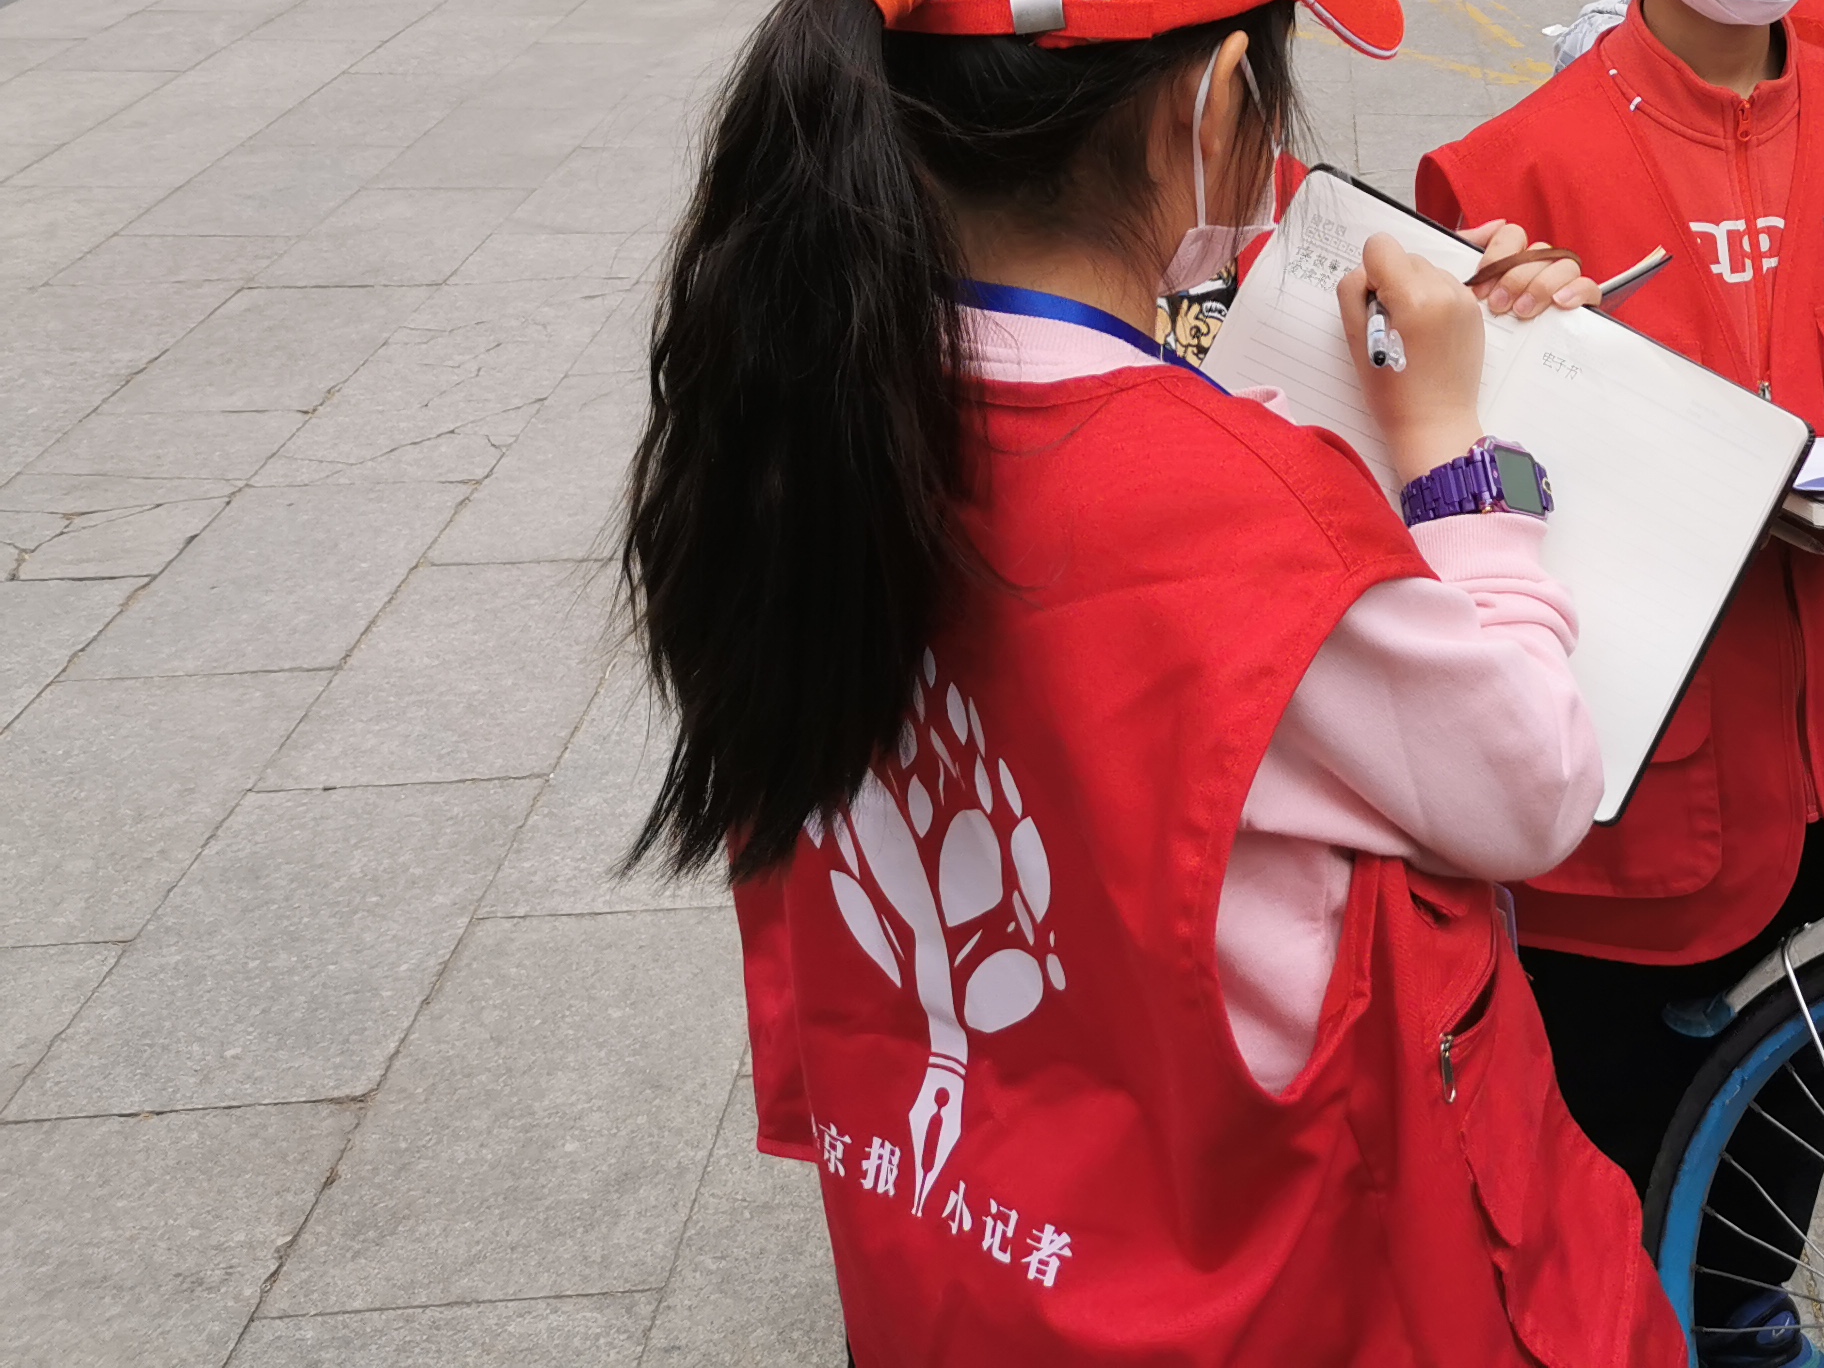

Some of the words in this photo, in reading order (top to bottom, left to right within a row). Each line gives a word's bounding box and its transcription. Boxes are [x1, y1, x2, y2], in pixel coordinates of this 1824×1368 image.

[811, 1114, 901, 1196] 京报
[942, 1180, 1072, 1287] 小记者
